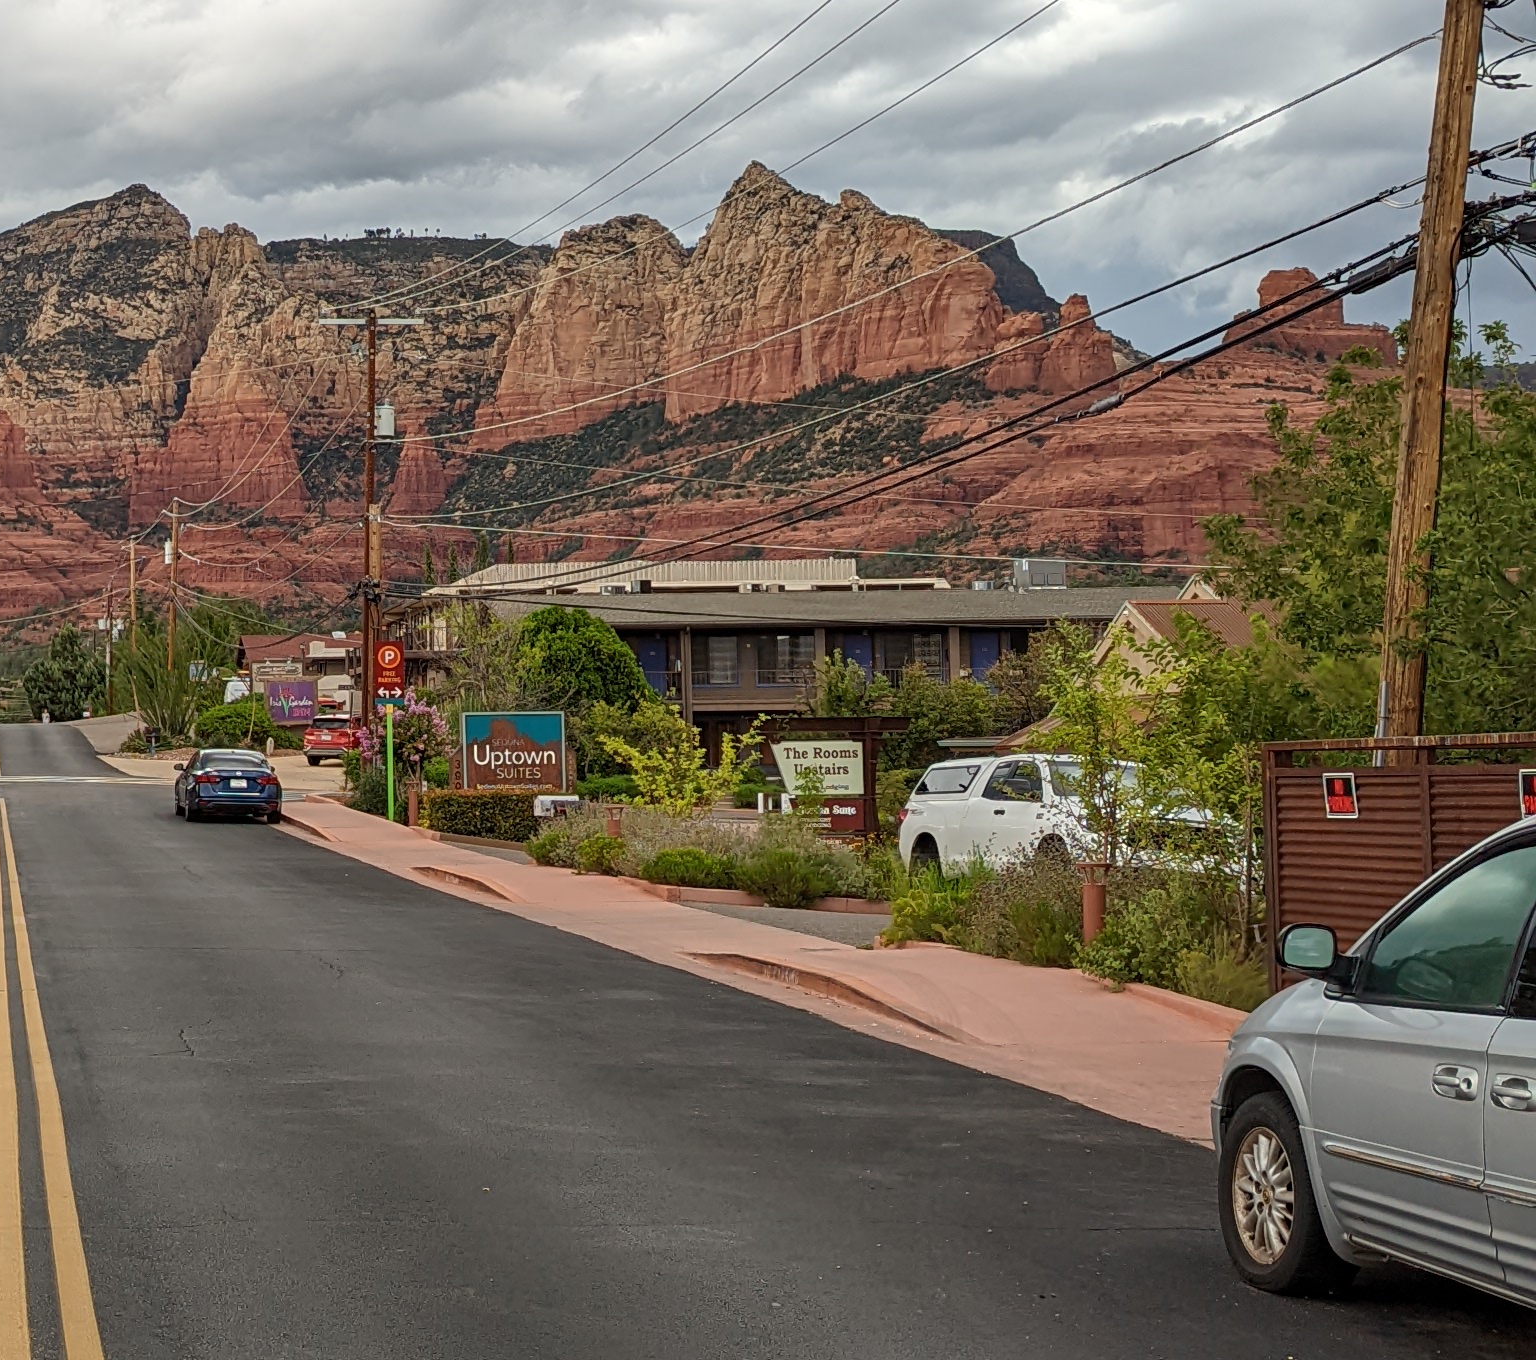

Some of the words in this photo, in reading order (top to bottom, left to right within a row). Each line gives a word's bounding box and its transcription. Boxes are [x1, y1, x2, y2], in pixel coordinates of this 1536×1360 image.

[385, 651, 395, 664] P
[473, 744, 556, 769] Uptown
[783, 747, 808, 759] The
[813, 747, 858, 759] Rooms
[496, 767, 541, 778] SUITES
